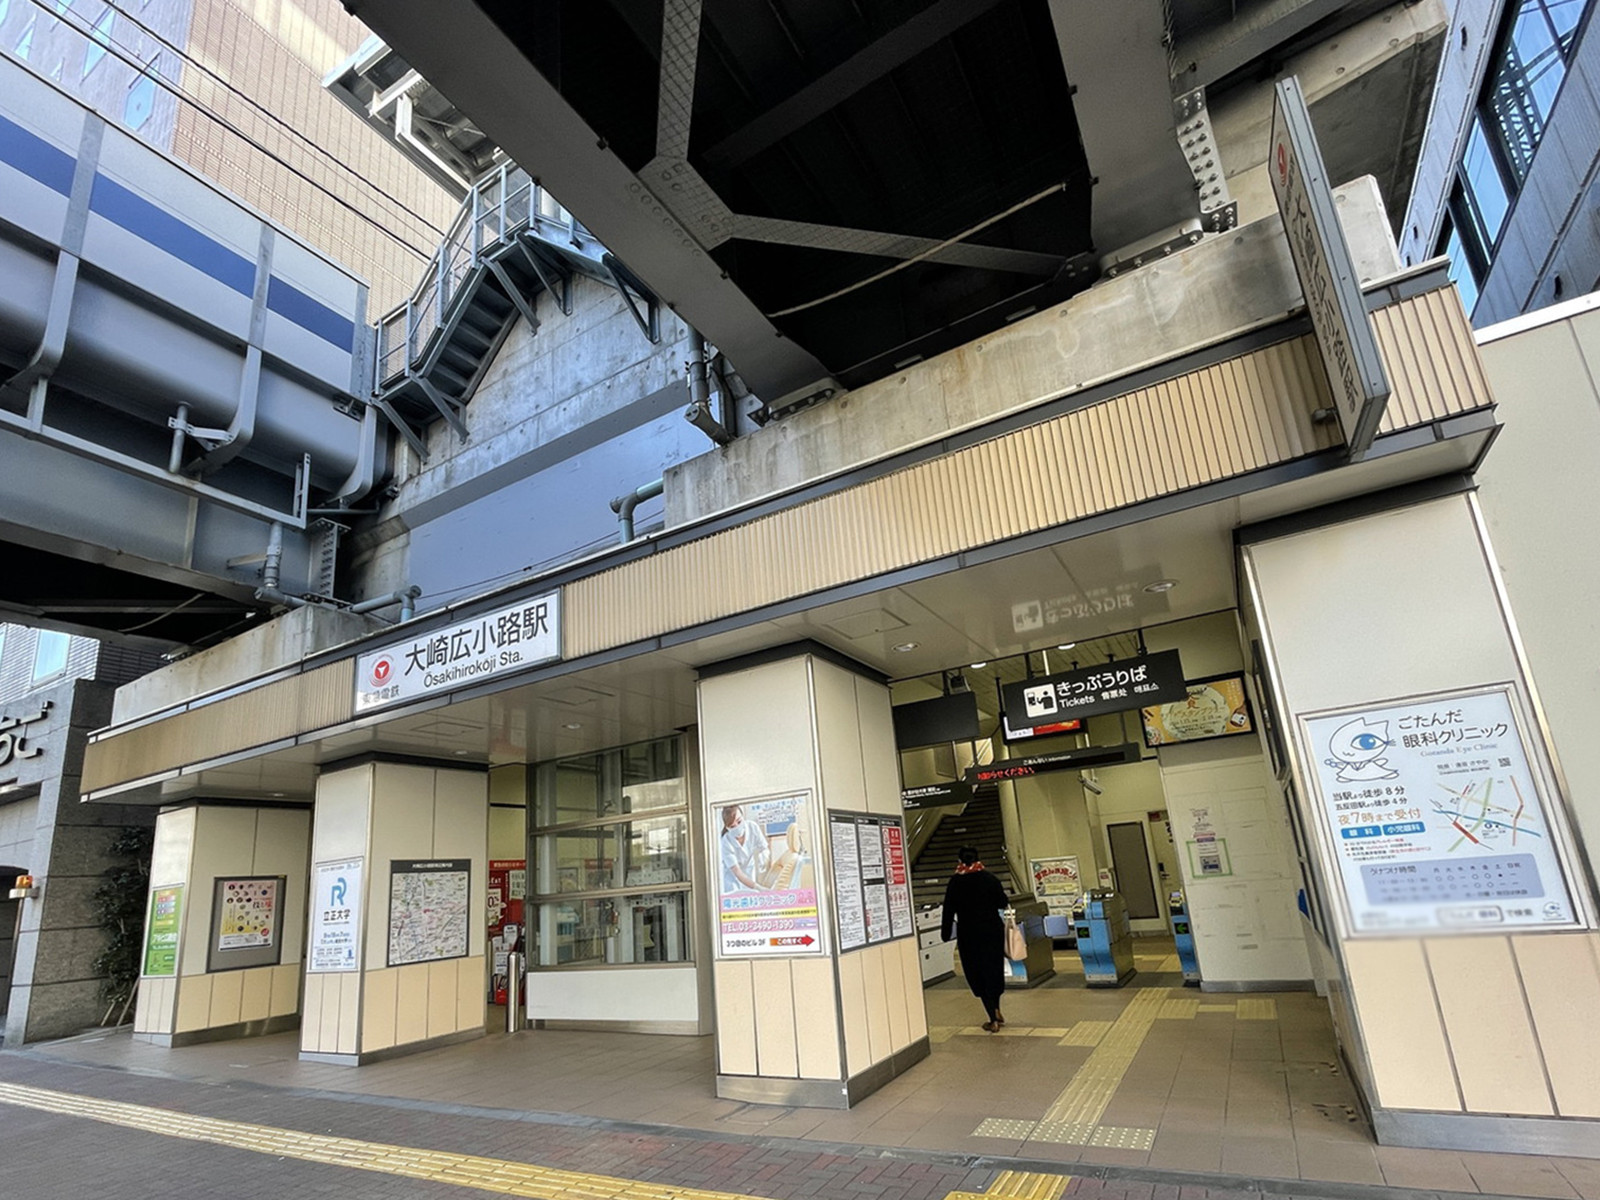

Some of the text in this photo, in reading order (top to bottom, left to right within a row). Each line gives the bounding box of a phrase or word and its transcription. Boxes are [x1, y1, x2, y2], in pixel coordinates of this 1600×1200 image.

[404, 602, 549, 676] 大崎広小路駅
[499, 650, 524, 666] Sta.
[1056, 665, 1148, 697] きっぷうりば
[1059, 694, 1096, 709] Tickets
[1398, 709, 1464, 730] ごたんだ
[1402, 722, 1508, 748] 眼科クリニック
[1338, 808, 1421, 825] 夜7時まで受付
[323, 909, 351, 921] 立正大学
